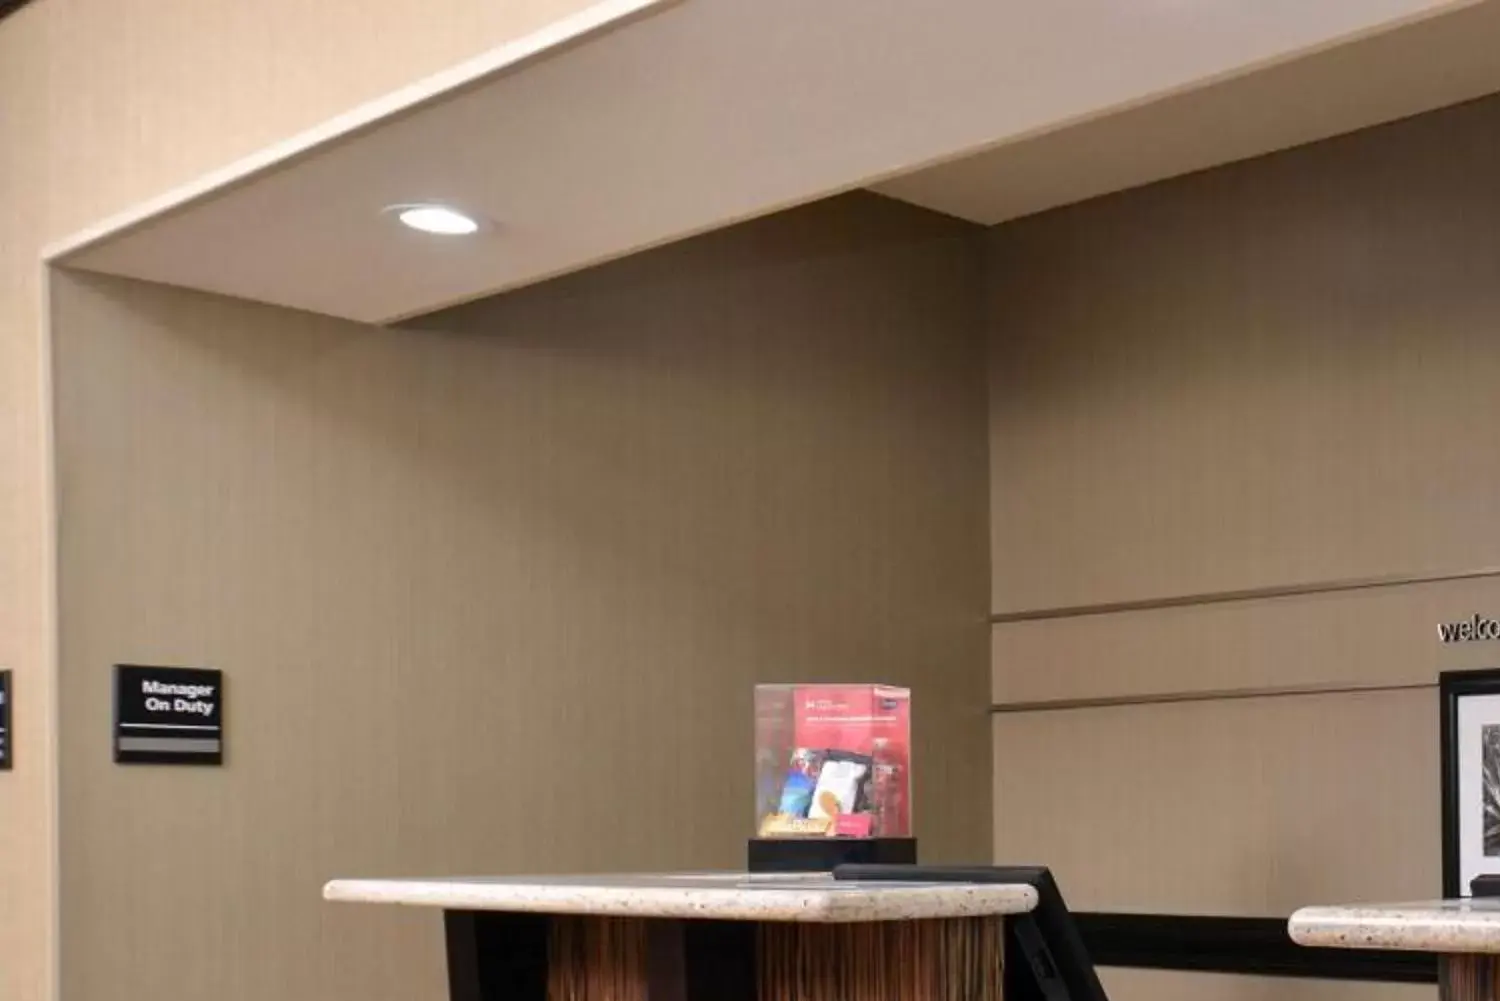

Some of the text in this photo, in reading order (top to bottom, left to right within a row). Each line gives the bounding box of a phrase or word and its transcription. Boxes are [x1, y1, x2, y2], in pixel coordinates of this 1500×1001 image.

[142, 680, 214, 699] Manager
[145, 697, 214, 716] On Duty
